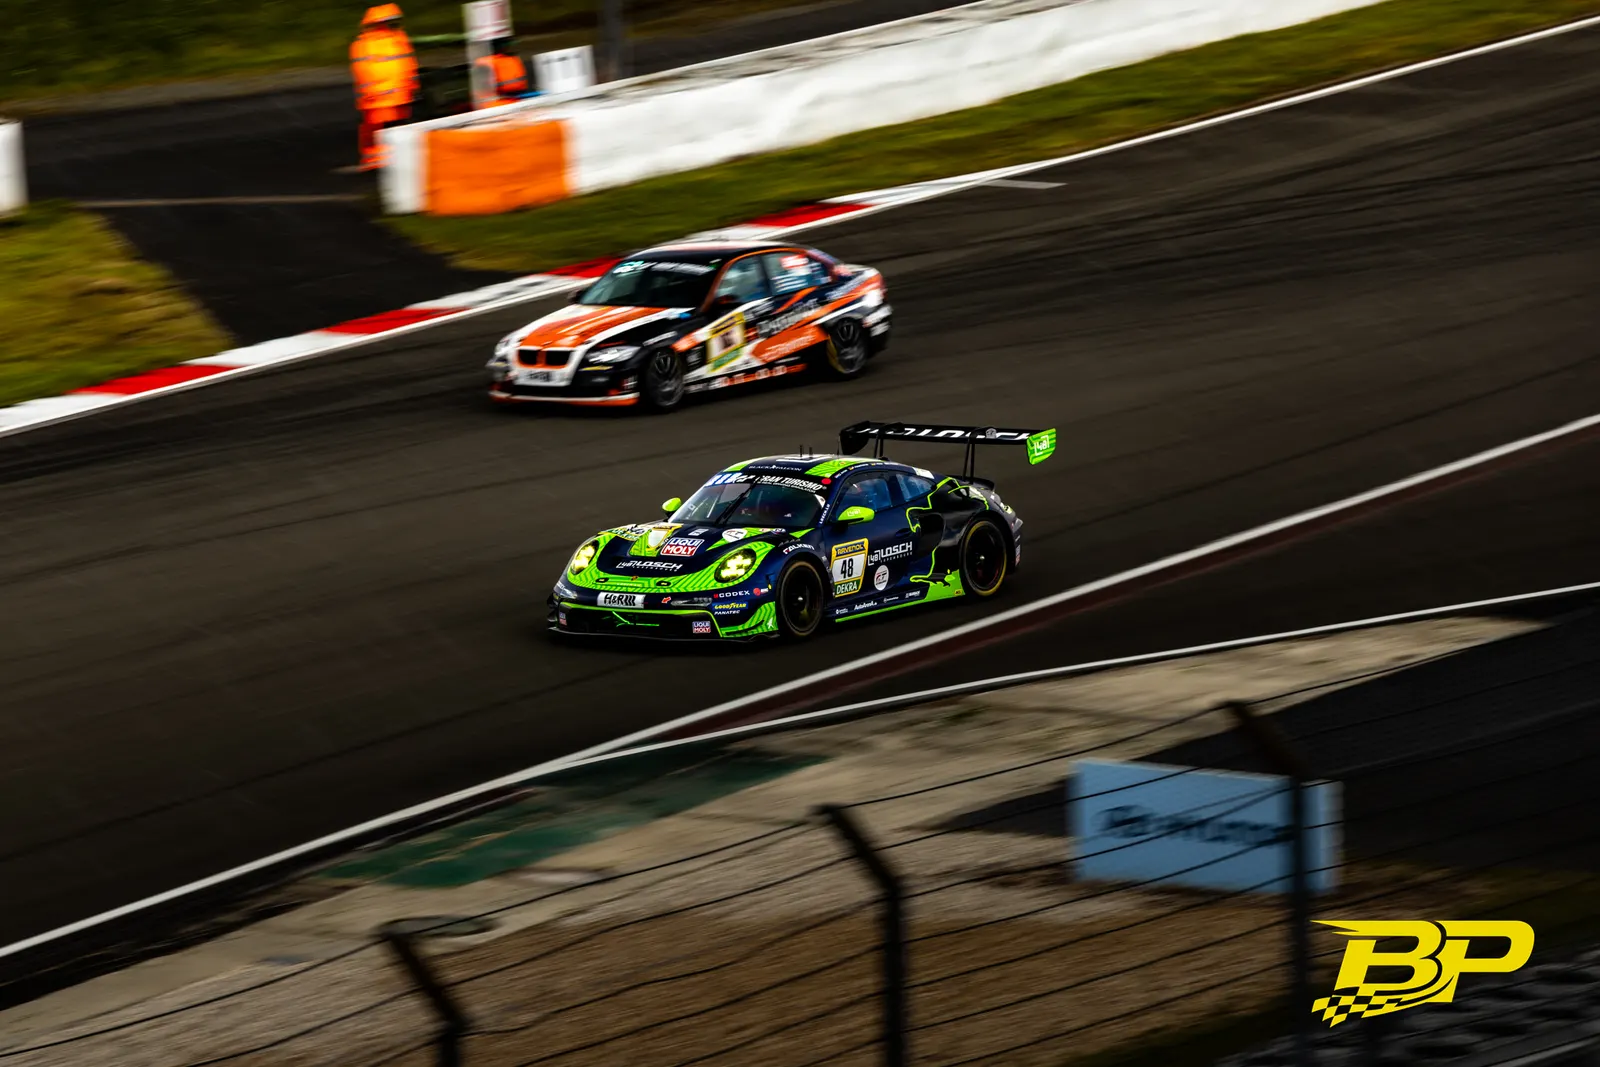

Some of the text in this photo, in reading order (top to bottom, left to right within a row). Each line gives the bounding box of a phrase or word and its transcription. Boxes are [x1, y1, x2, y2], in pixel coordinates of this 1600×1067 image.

[781, 477, 823, 491] TURISMO
[669, 538, 701, 547] LIQUI
[663, 545, 697, 555] MOLY
[837, 544, 864, 555] RAVENOL
[880, 541, 913, 558] LOSCH
[636, 560, 684, 569] LOSCH
[840, 557, 854, 579] 48
[836, 581, 858, 595] DEKRA
[603, 593, 625, 605] H&R
[719, 590, 751, 598] CODEX
